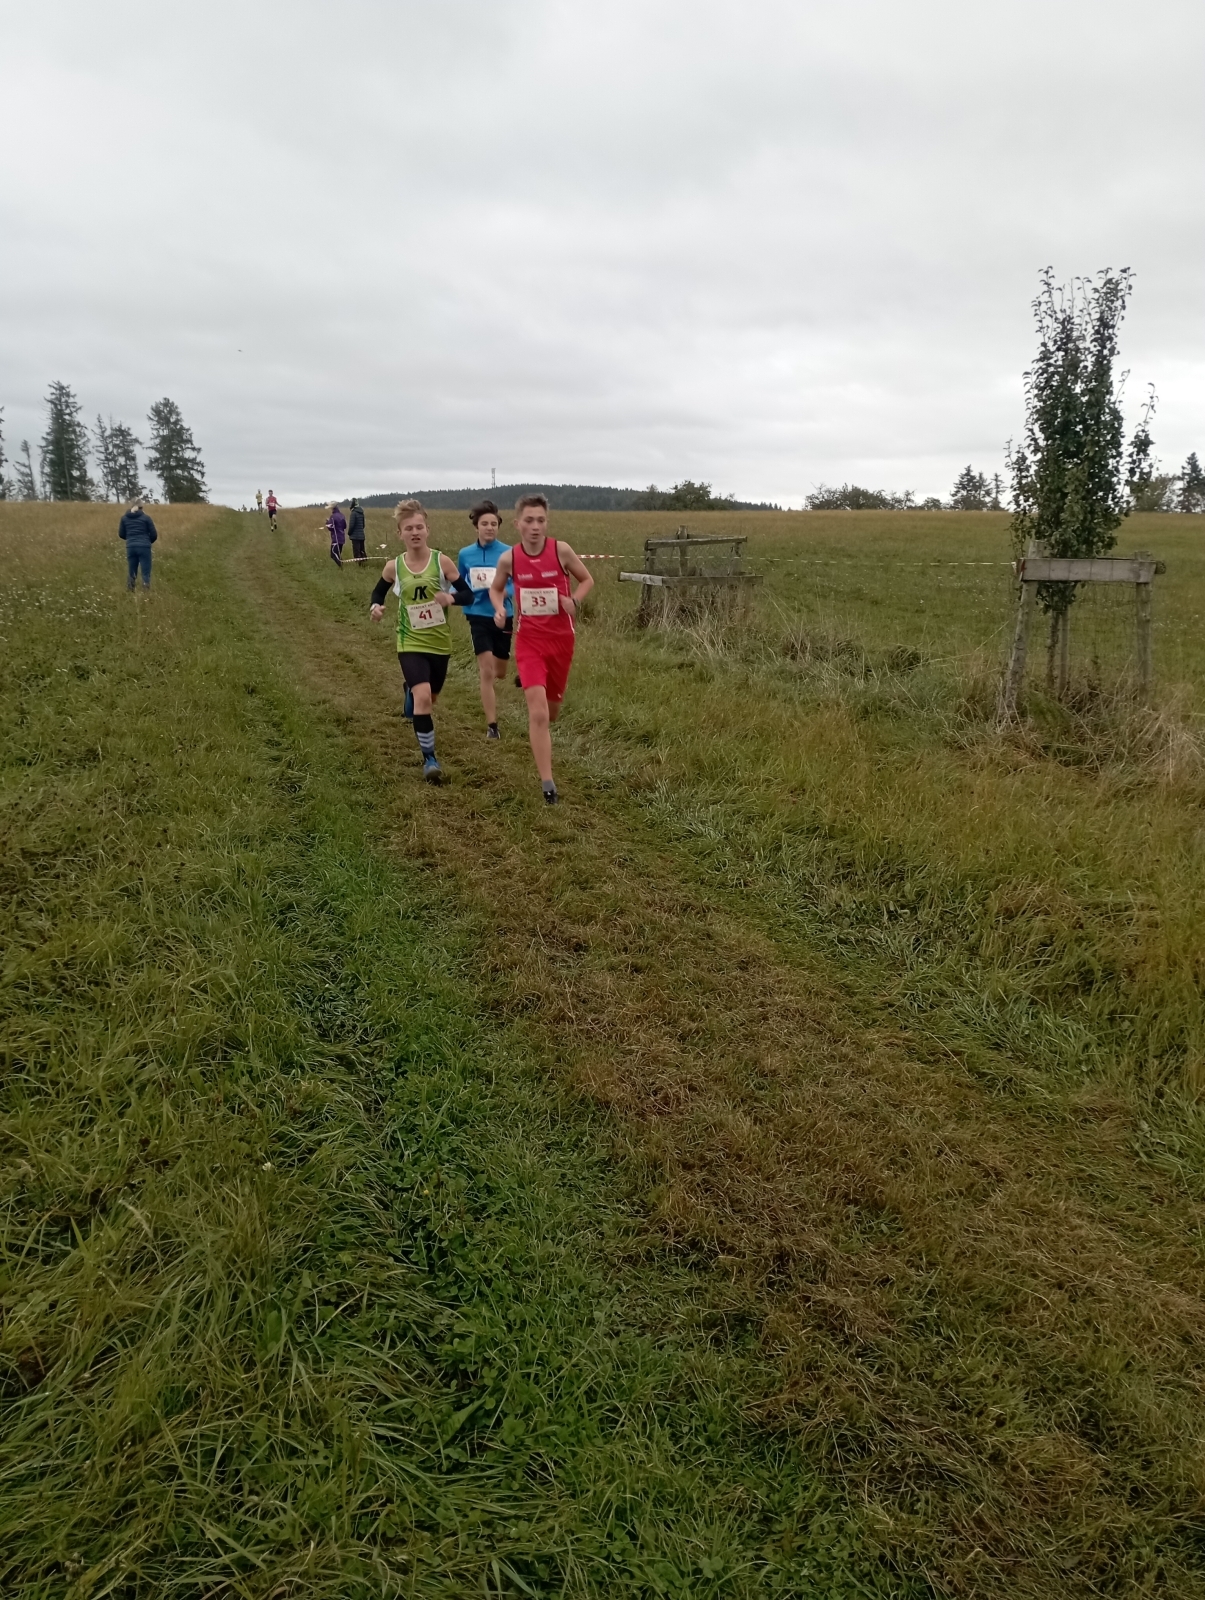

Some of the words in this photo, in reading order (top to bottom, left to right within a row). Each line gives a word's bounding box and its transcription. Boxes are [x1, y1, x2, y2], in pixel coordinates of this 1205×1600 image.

[477, 572, 487, 582] 43
[531, 596, 547, 608] 33
[419, 609, 432, 620] 41
